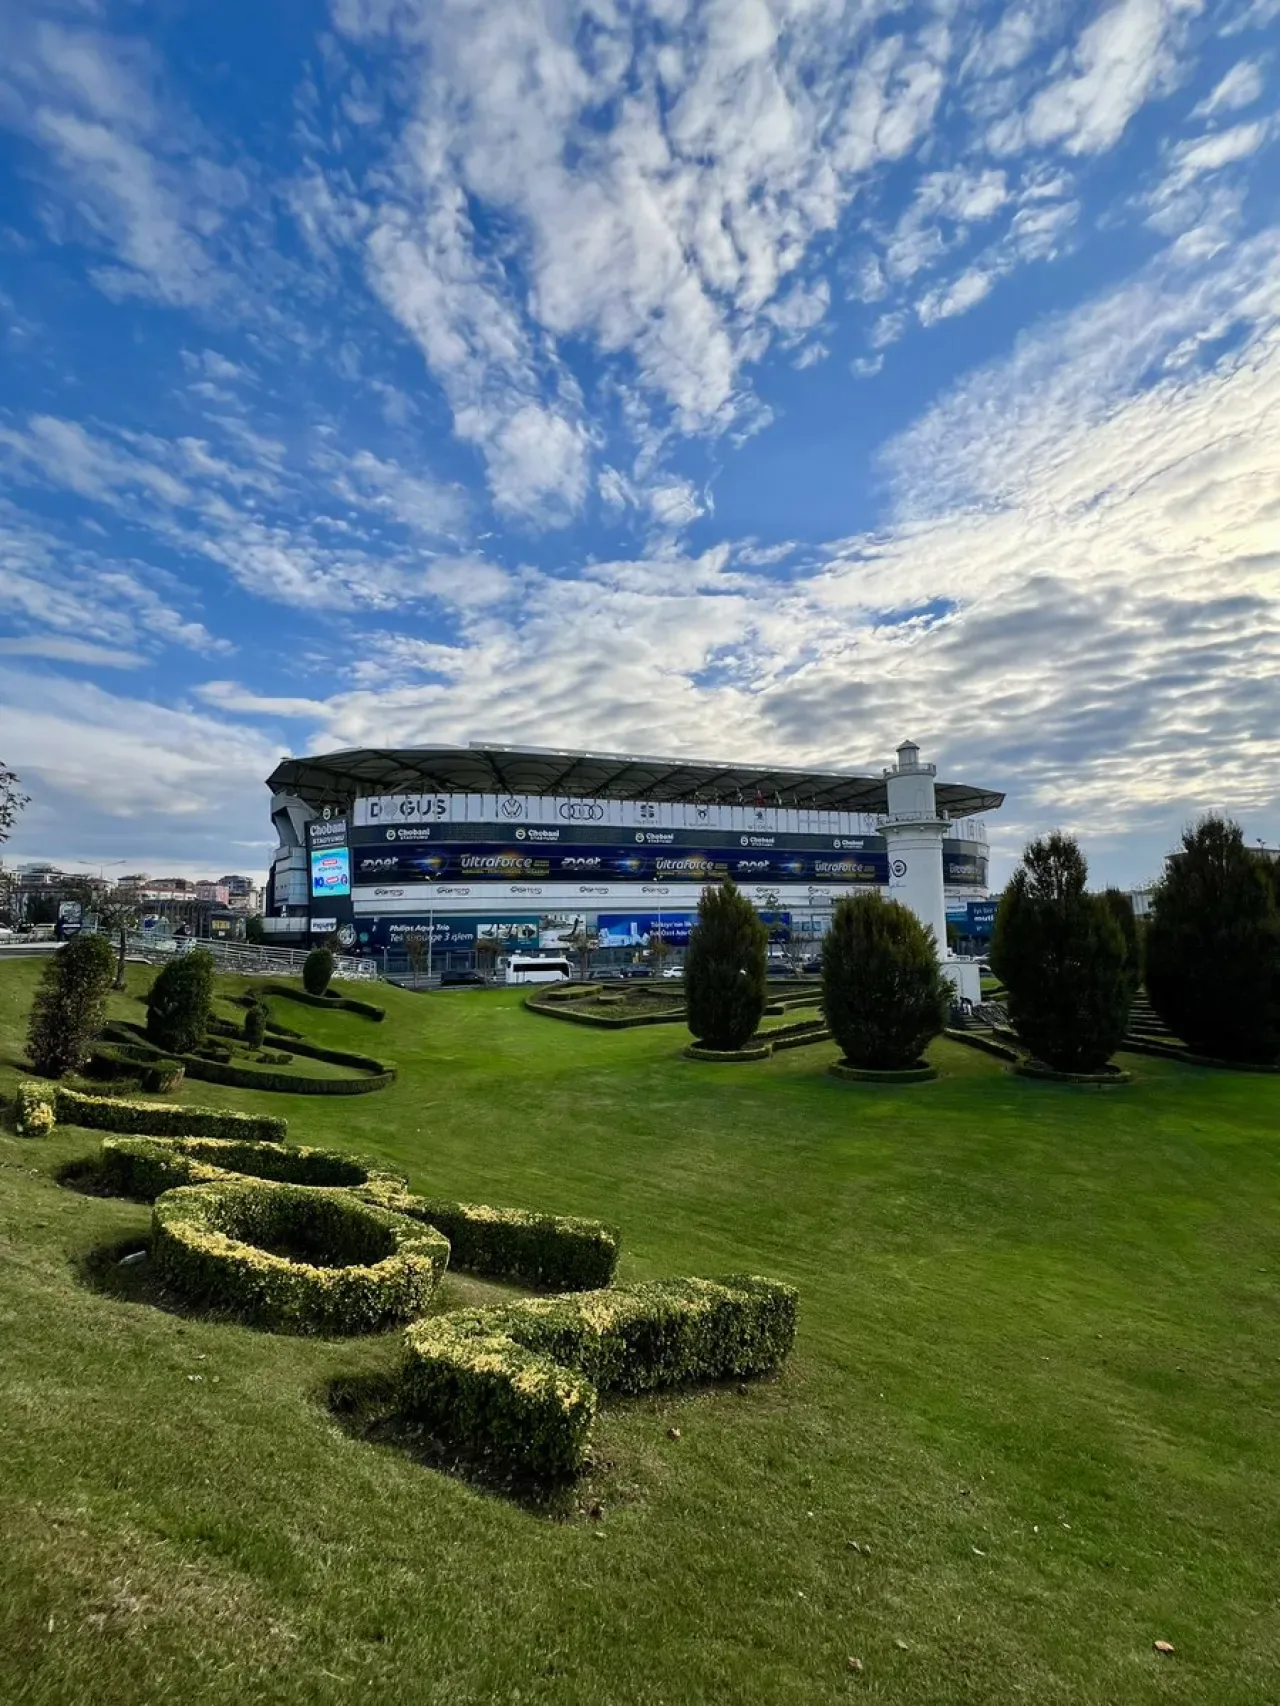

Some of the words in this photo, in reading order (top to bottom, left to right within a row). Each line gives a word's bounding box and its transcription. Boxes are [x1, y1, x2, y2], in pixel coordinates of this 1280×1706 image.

[310, 820, 346, 836] Chobani
[398, 828, 430, 837] Chobani
[528, 829, 559, 837] Chobani
[389, 924, 414, 933] Philips
[436, 923, 450, 931] Trio
